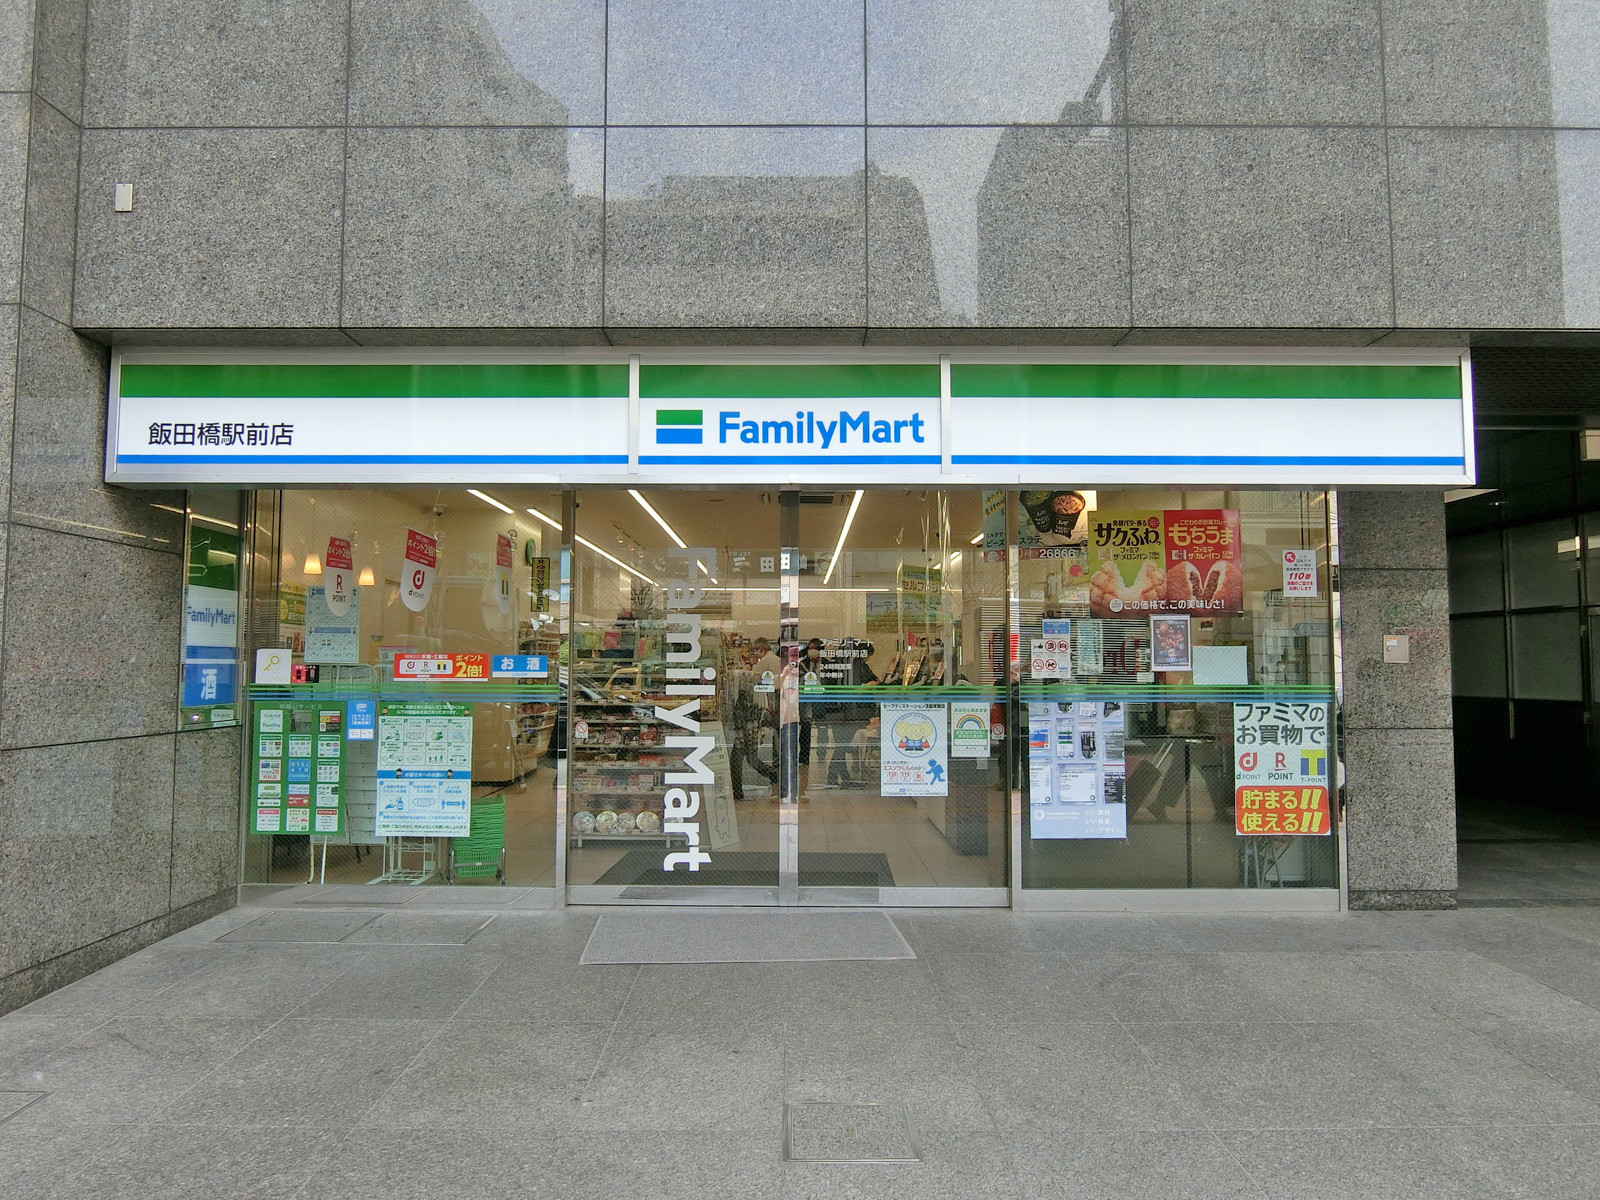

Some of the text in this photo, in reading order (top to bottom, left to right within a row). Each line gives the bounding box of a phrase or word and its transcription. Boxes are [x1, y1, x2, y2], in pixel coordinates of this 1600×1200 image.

[148, 422, 294, 446] 飯田橋駅前店
[719, 411, 925, 449] FamilyMart
[1094, 523, 1162, 546] サクふわっ
[1168, 523, 1234, 547] もちうま
[1040, 549, 1076, 558] 26866
[333, 594, 346, 603] POINT
[820, 638, 875, 647] ファミリーマート
[455, 654, 483, 662] ポイント
[501, 657, 540, 671] お酒
[820, 649, 868, 658] 飯田橋駅前店
[454, 661, 483, 678] 2倍!
[200, 668, 218, 700] 酒
[655, 547, 717, 872] FamilyMart
[1235, 702, 1325, 723] ファミマの
[1236, 725, 1326, 746] お買物で
[1275, 752, 1287, 768] R
[1241, 788, 1323, 810] 貯まる!!
[1241, 811, 1323, 833] 使える!!
